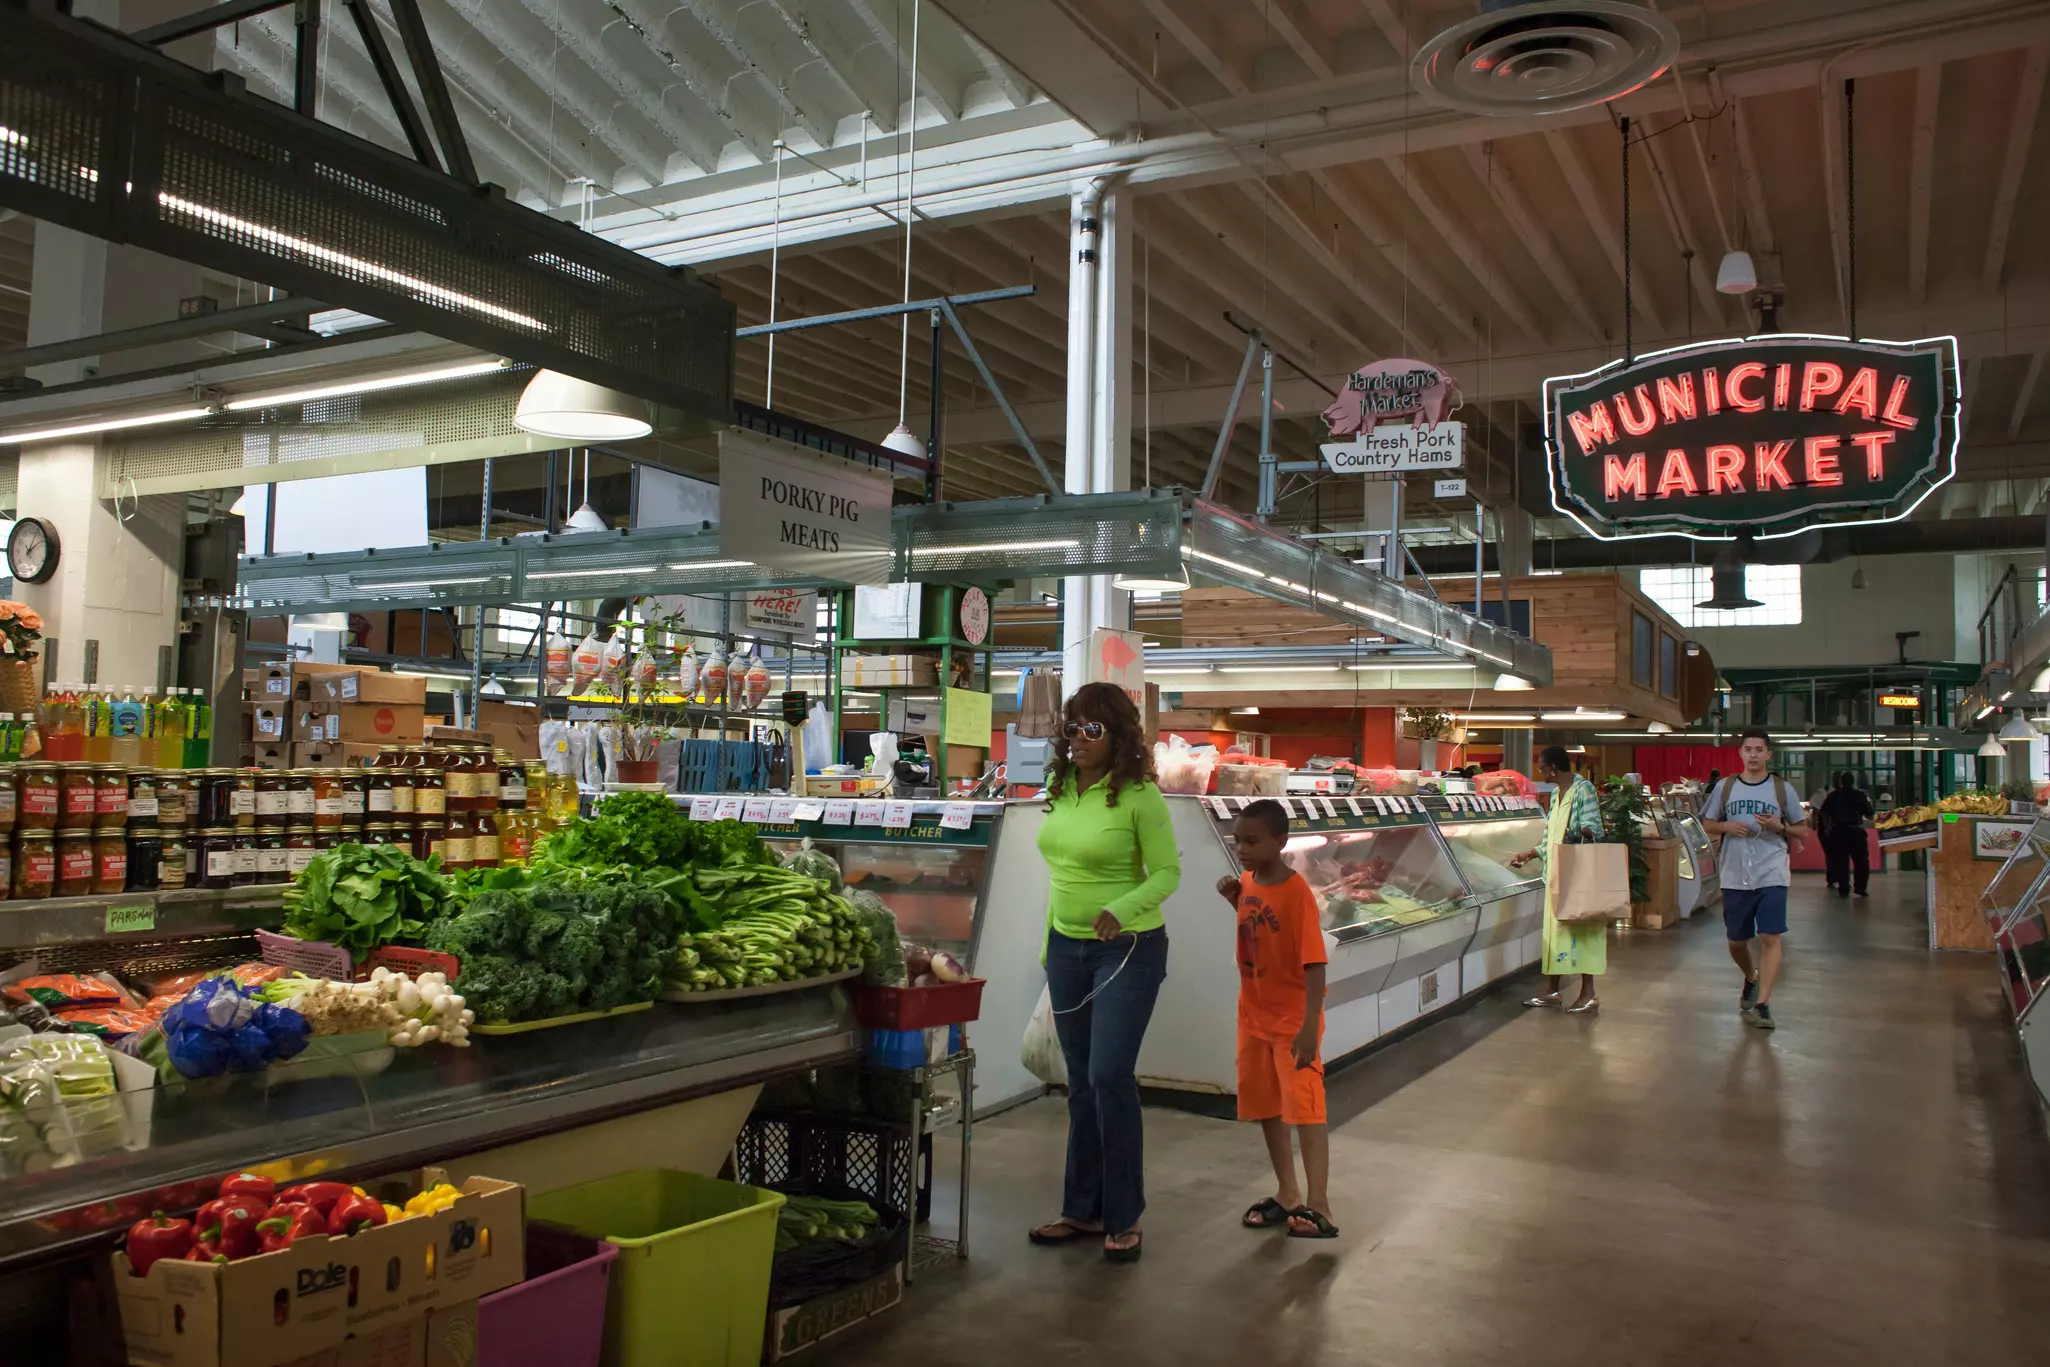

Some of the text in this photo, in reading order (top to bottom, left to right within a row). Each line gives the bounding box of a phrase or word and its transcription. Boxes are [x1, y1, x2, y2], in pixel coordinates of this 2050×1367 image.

[1347, 370, 1438, 391] Hardeman's
[1360, 392, 1423, 416] Market
[1567, 361, 1919, 456] MUNICIPAL
[1366, 430, 1455, 451] Fresh Pork
[1335, 448, 1453, 468] Country Hams
[1604, 431, 1896, 503] MARKET
[760, 476, 826, 517] PORKY
[828, 495, 860, 523] PIG
[780, 520, 840, 554] MEATS
[753, 595, 801, 613] HERE!
[1882, 696, 1918, 706] RESTROOMS
[885, 826, 942, 838] BUTCHER
[297, 1261, 348, 1293] Dole
